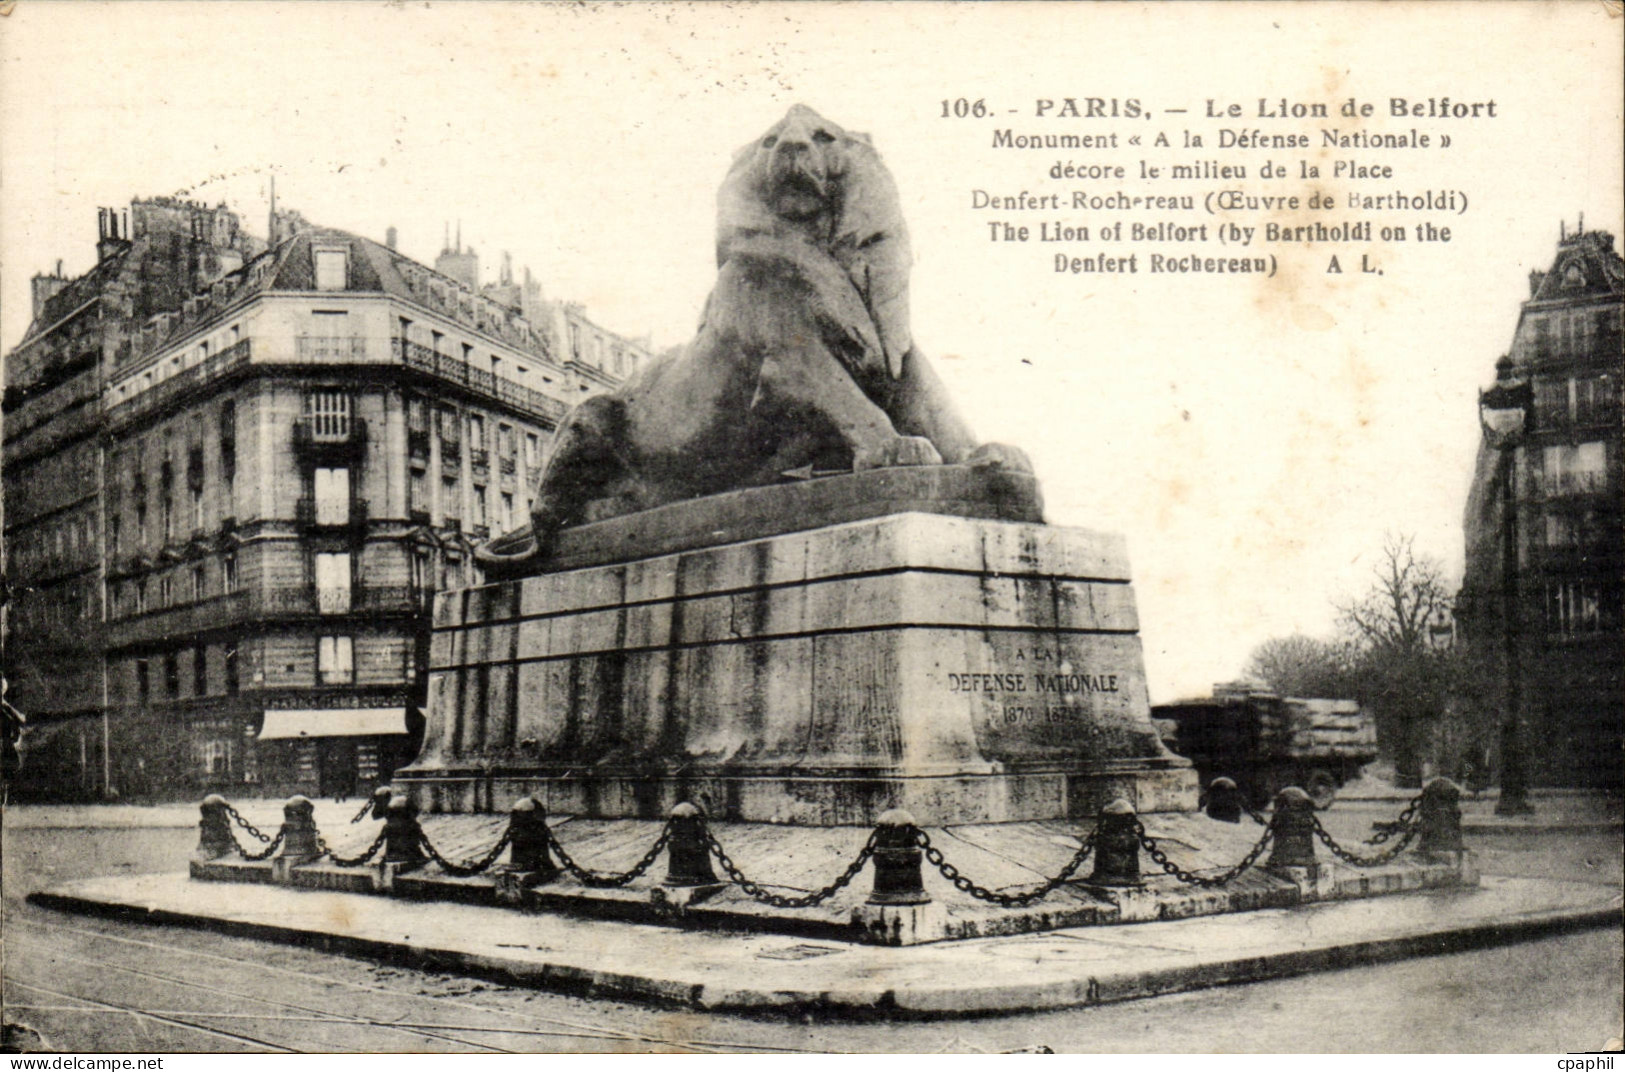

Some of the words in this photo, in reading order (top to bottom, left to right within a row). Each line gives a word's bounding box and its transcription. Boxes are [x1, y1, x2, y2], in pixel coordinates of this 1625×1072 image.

[1016, 648, 1026, 661] A
[1034, 648, 1054, 661] LA
[948, 673, 1027, 693] DEFENSE
[1034, 674, 1119, 694] NATIONALE
[1003, 706, 1034, 724] 1870
